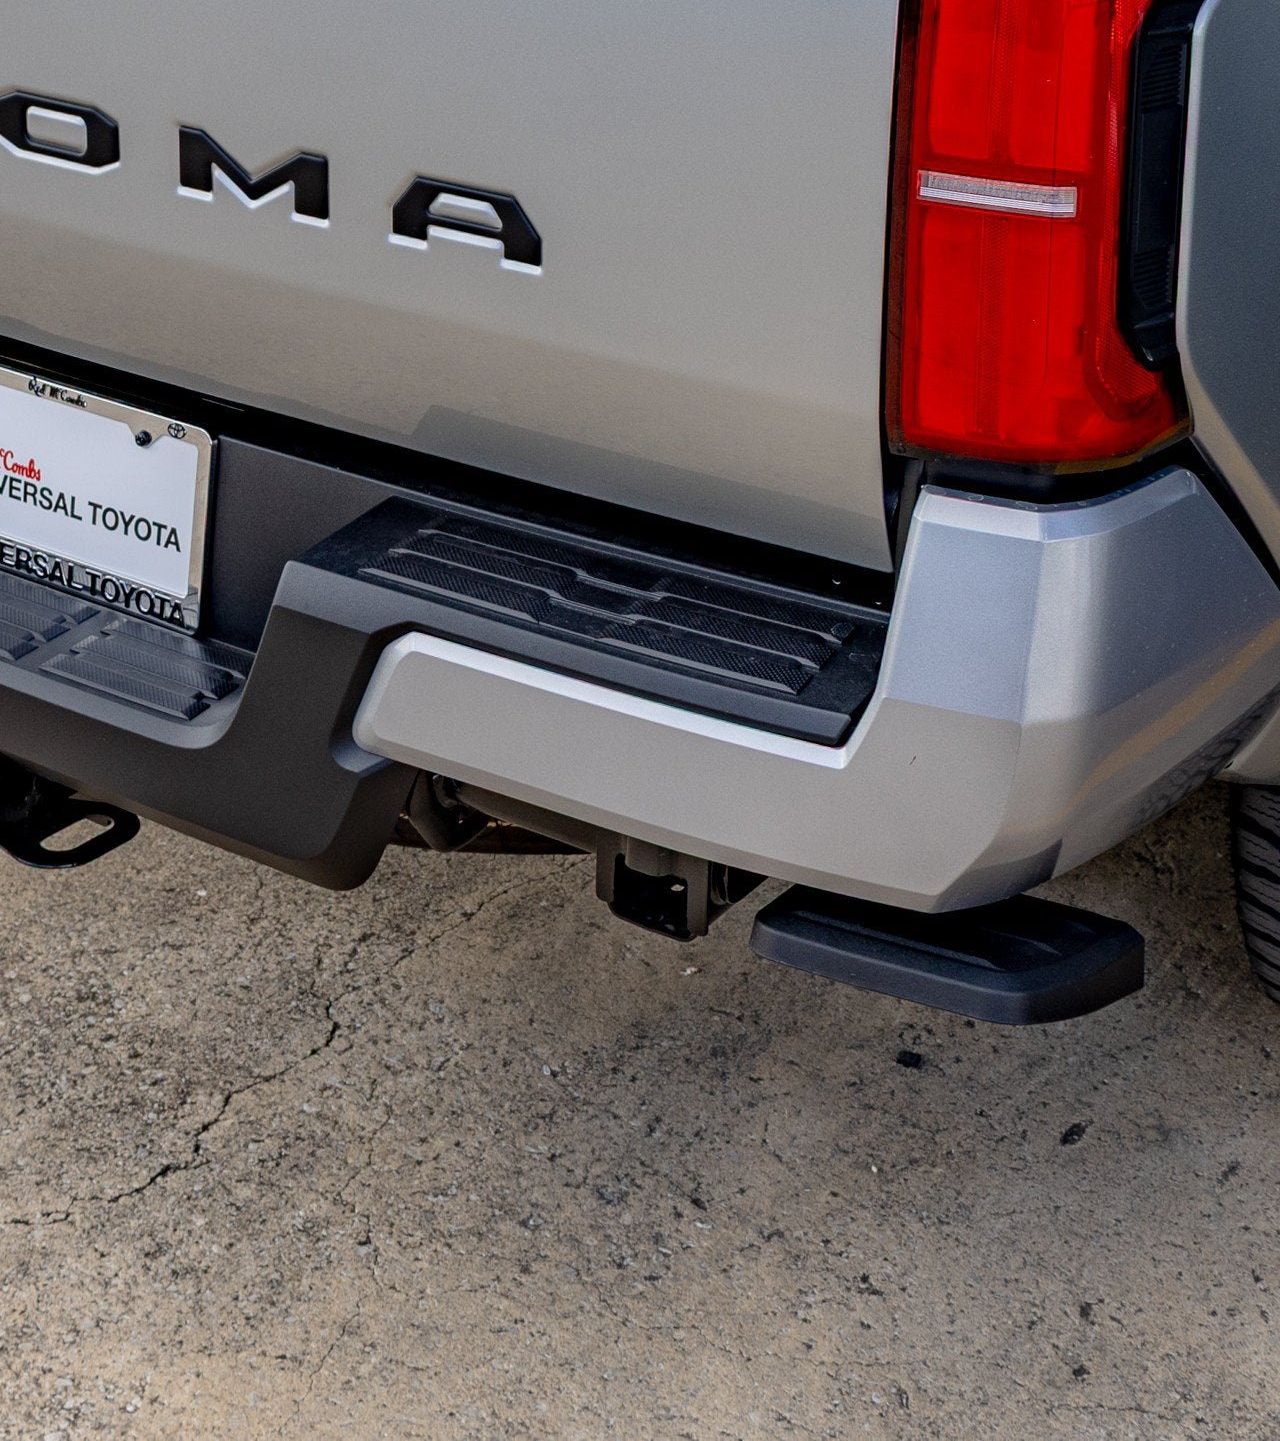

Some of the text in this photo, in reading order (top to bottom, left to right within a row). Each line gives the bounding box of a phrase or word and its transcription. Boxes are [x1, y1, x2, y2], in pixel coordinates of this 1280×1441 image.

[28, 375, 47, 397] Red
[88, 501, 182, 553] TOYOTA
[85, 568, 187, 629] TOYOTA
